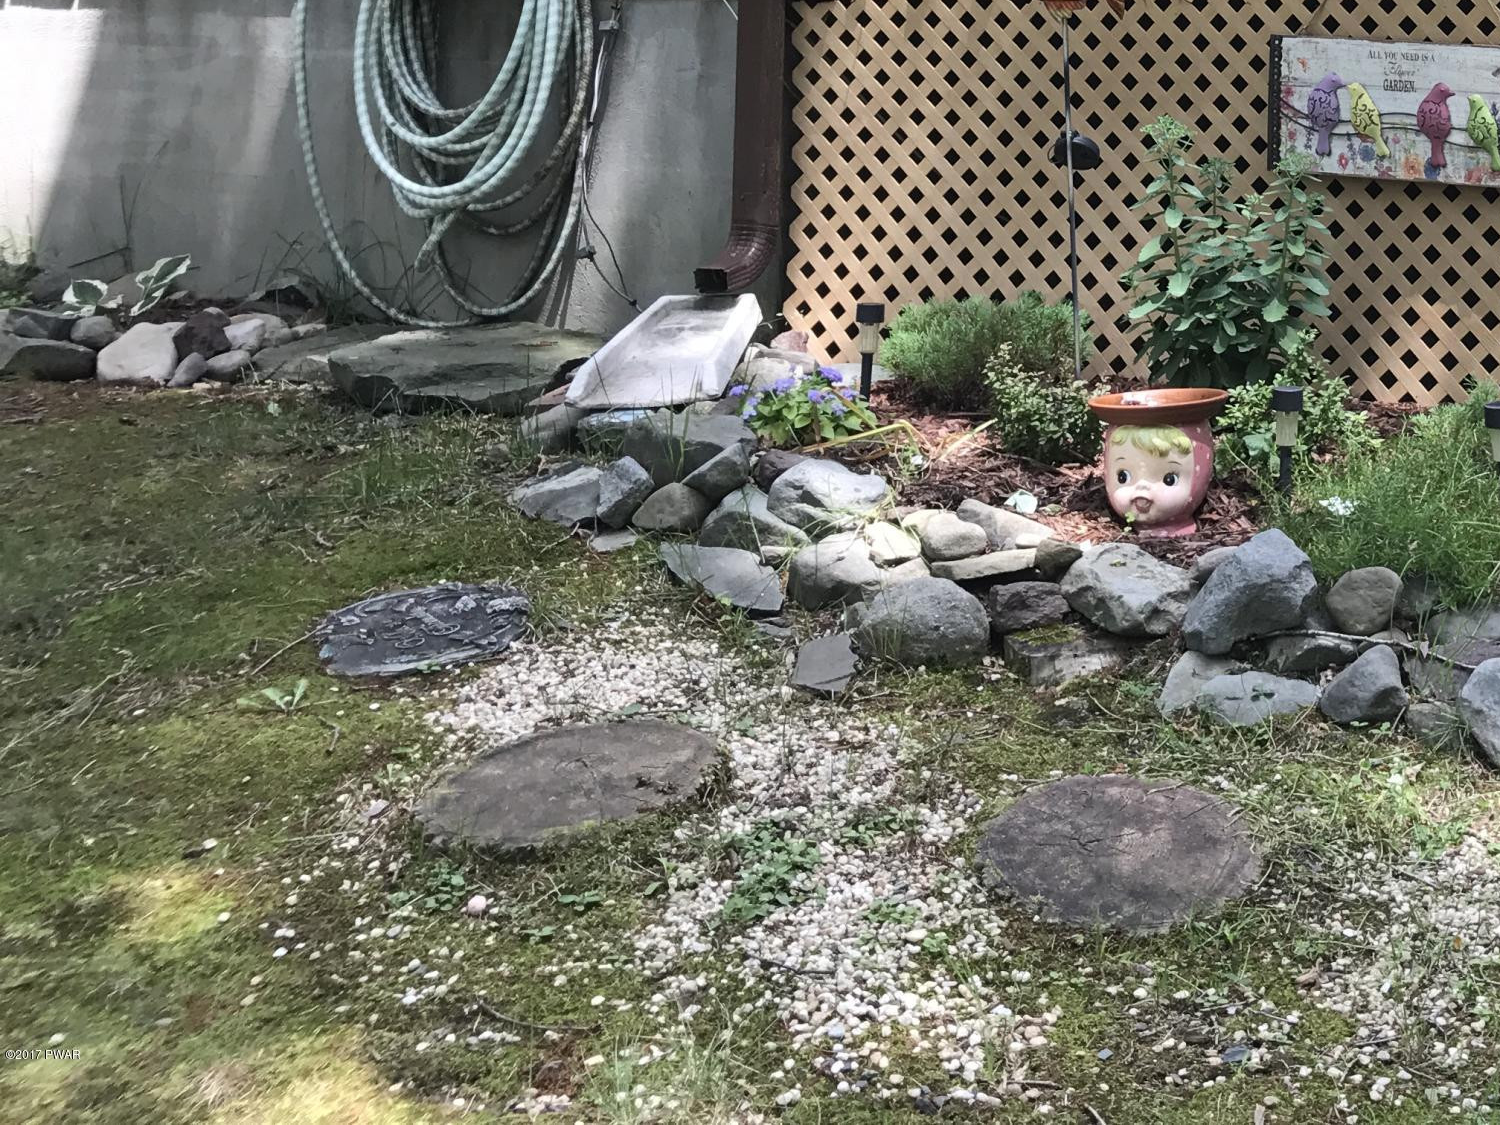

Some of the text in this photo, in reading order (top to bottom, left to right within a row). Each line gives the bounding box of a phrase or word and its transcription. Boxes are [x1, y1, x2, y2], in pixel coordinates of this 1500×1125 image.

[1368, 50, 1382, 60] ALL
[1384, 51, 1398, 60] YOU
[1401, 52, 1419, 62] NEED
[1421, 53, 1428, 62] IS
[1383, 78, 1417, 93] GARDEN.
